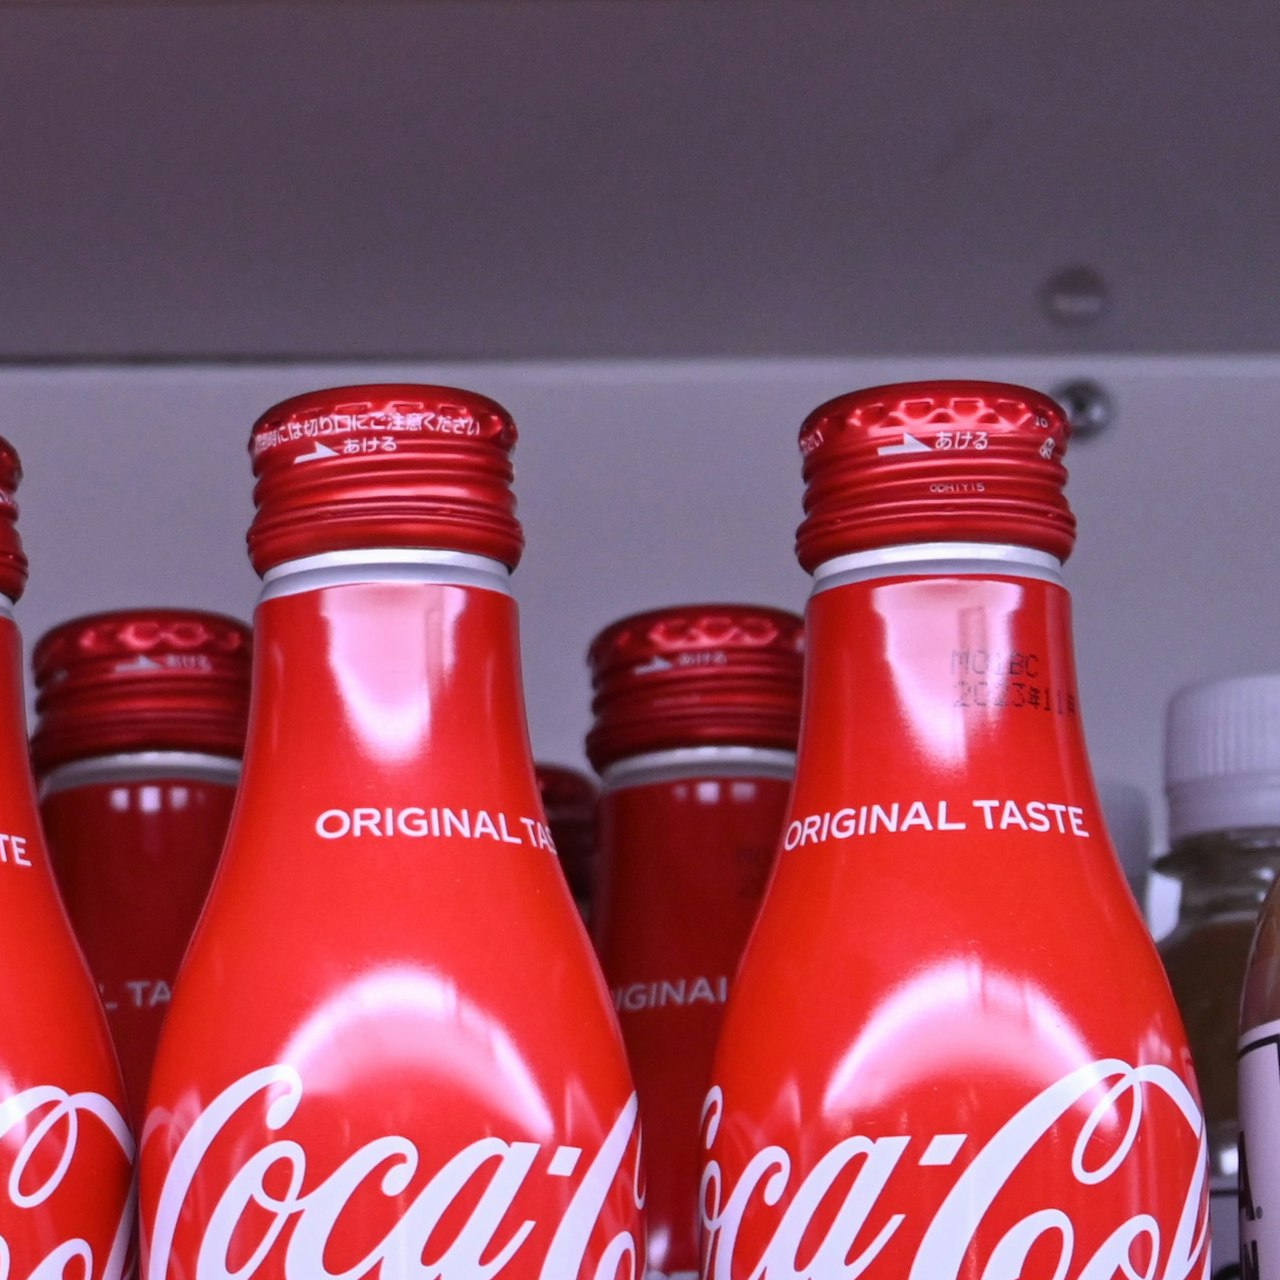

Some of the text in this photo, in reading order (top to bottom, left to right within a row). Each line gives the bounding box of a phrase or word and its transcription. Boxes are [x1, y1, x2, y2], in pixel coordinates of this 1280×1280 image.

[343, 436, 398, 455] あける
[935, 431, 989, 451] あける
[316, 807, 522, 846] ORIGINAL
[784, 800, 1091, 851] ORIGINAL TASTE
